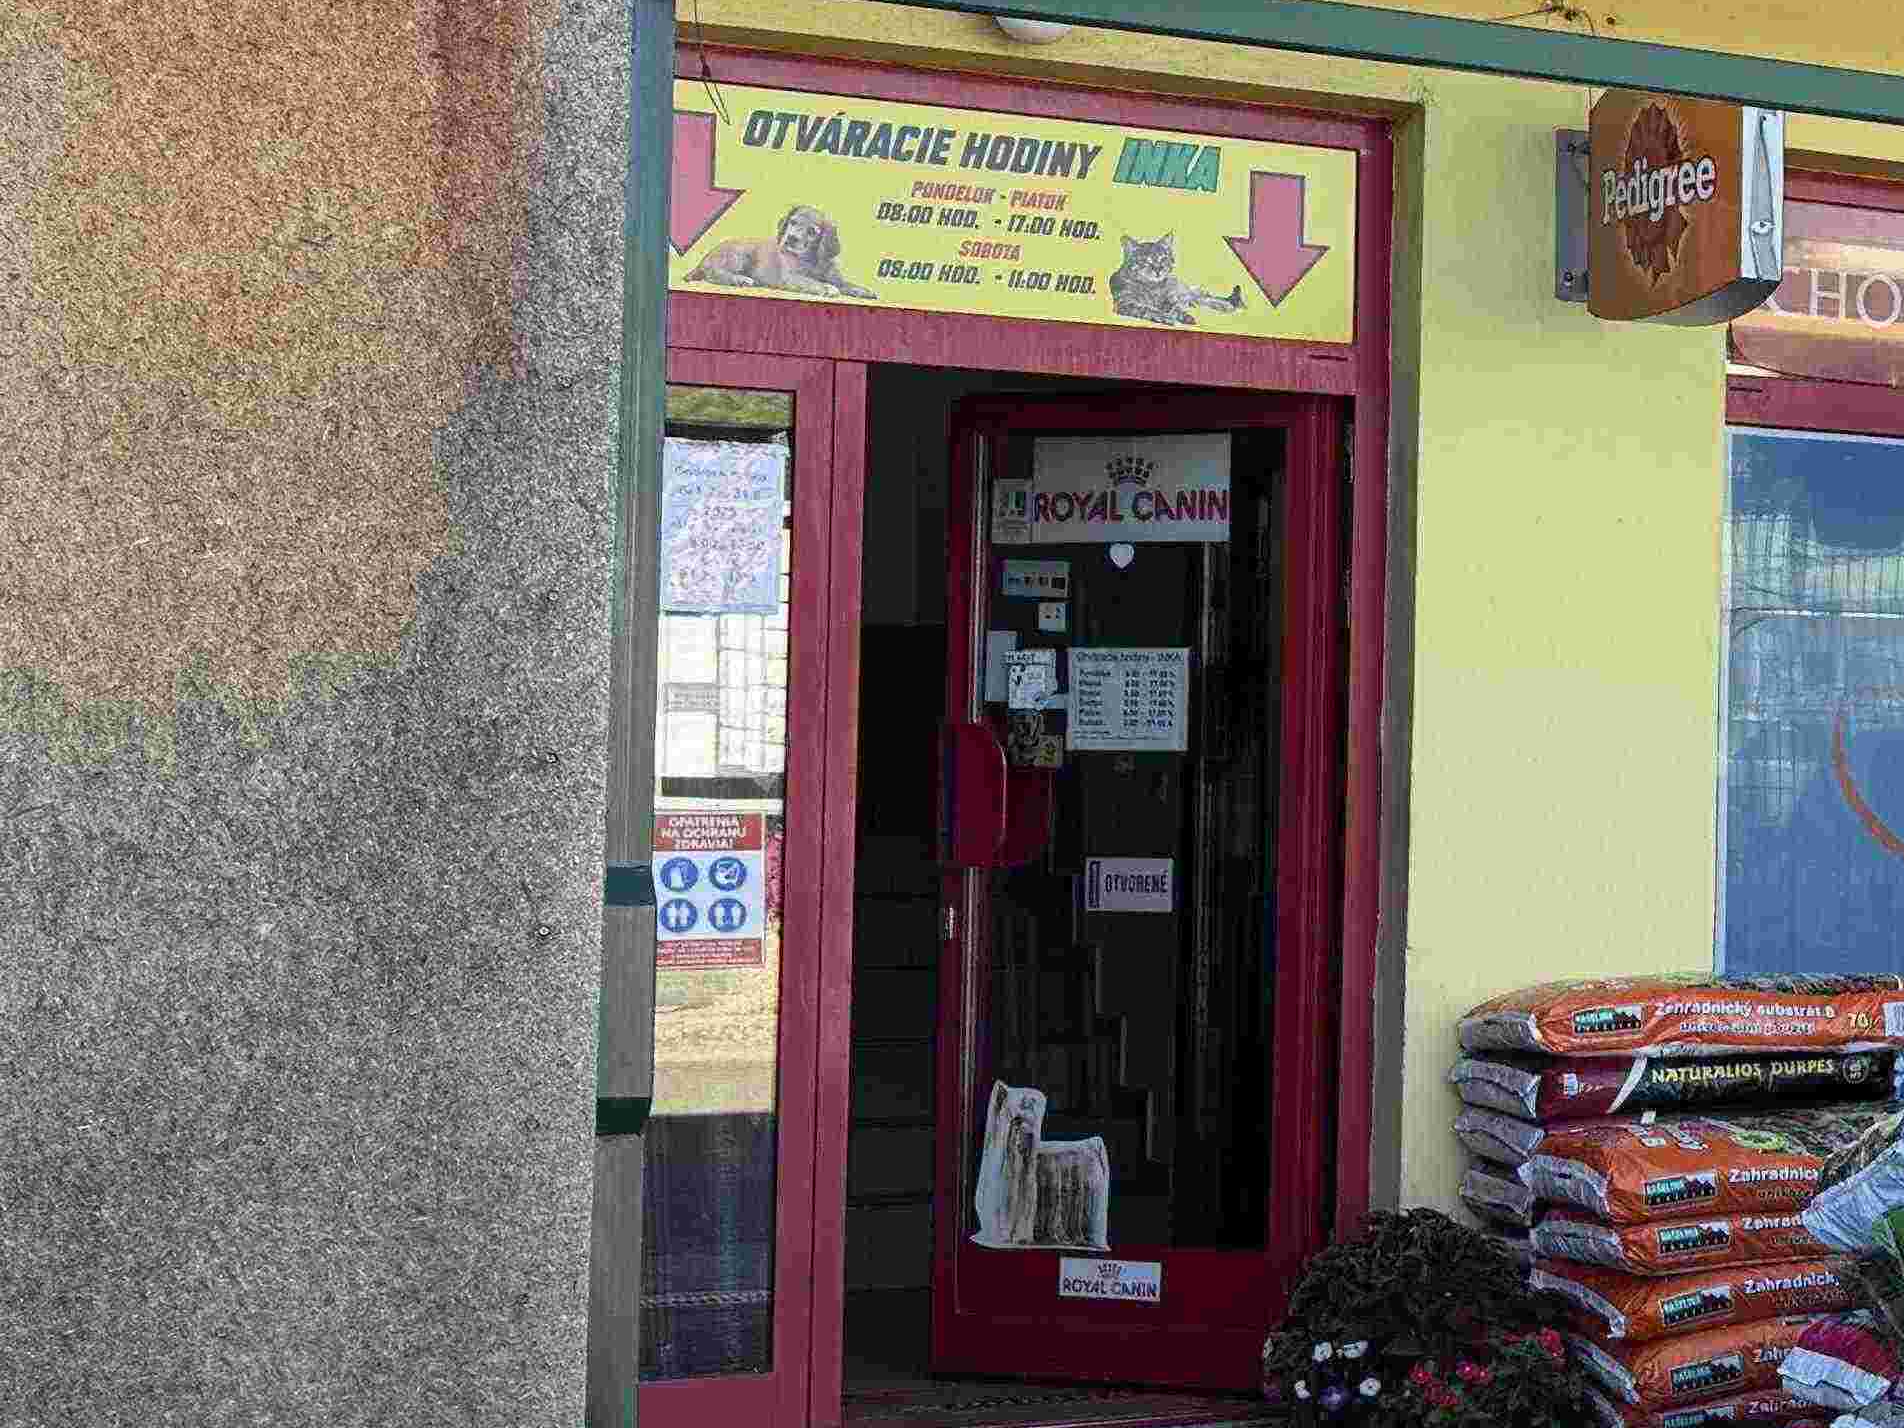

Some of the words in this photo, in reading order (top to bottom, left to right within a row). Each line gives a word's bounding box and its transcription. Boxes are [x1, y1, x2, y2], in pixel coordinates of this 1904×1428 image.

[742, 109, 957, 166] OTVÁRACIE
[959, 131, 1101, 180] HODINY
[1600, 156, 1717, 225] Pedigree
[1034, 489, 1121, 523] ROYAL
[1132, 489, 1231, 523] CANIN
